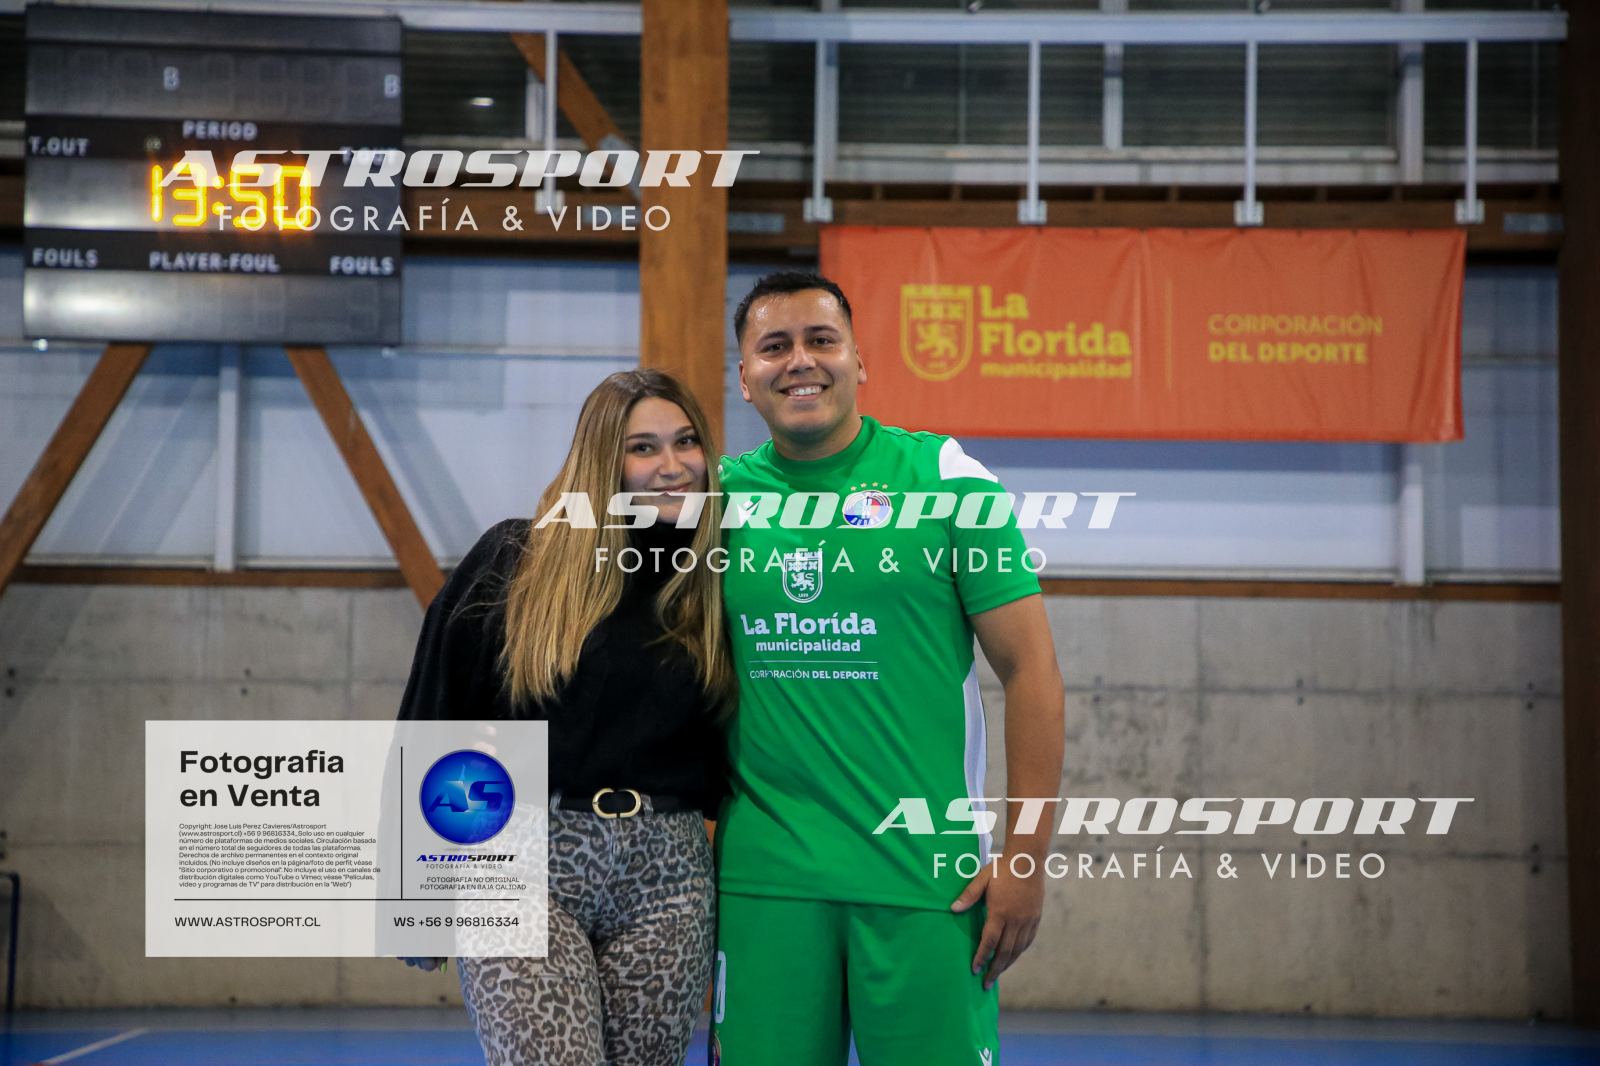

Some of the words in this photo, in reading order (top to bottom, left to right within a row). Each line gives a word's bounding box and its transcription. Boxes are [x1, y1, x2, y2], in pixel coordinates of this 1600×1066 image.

[163, 67, 180, 91] B
[384, 74, 400, 98] B
[182, 120, 257, 140] PERIOD
[30, 137, 89, 155] T.OUT
[151, 162, 311, 229] 13:50
[33, 247, 98, 266] FOULS
[149, 251, 279, 273] PLAYER-FOUL
[330, 256, 394, 275] FOULS
[980, 285, 1028, 319] La
[1208, 311, 1383, 336] CORPORACIÓN
[1209, 343, 1251, 364] DEL
[1258, 343, 1367, 364] DEPORTE
[980, 359, 1132, 380] municipalidad
[740, 614, 770, 635] La
[756, 639, 860, 654] municipalidad
[812, 671, 831, 679] DEL
[833, 671, 879, 680] DEPORTE
